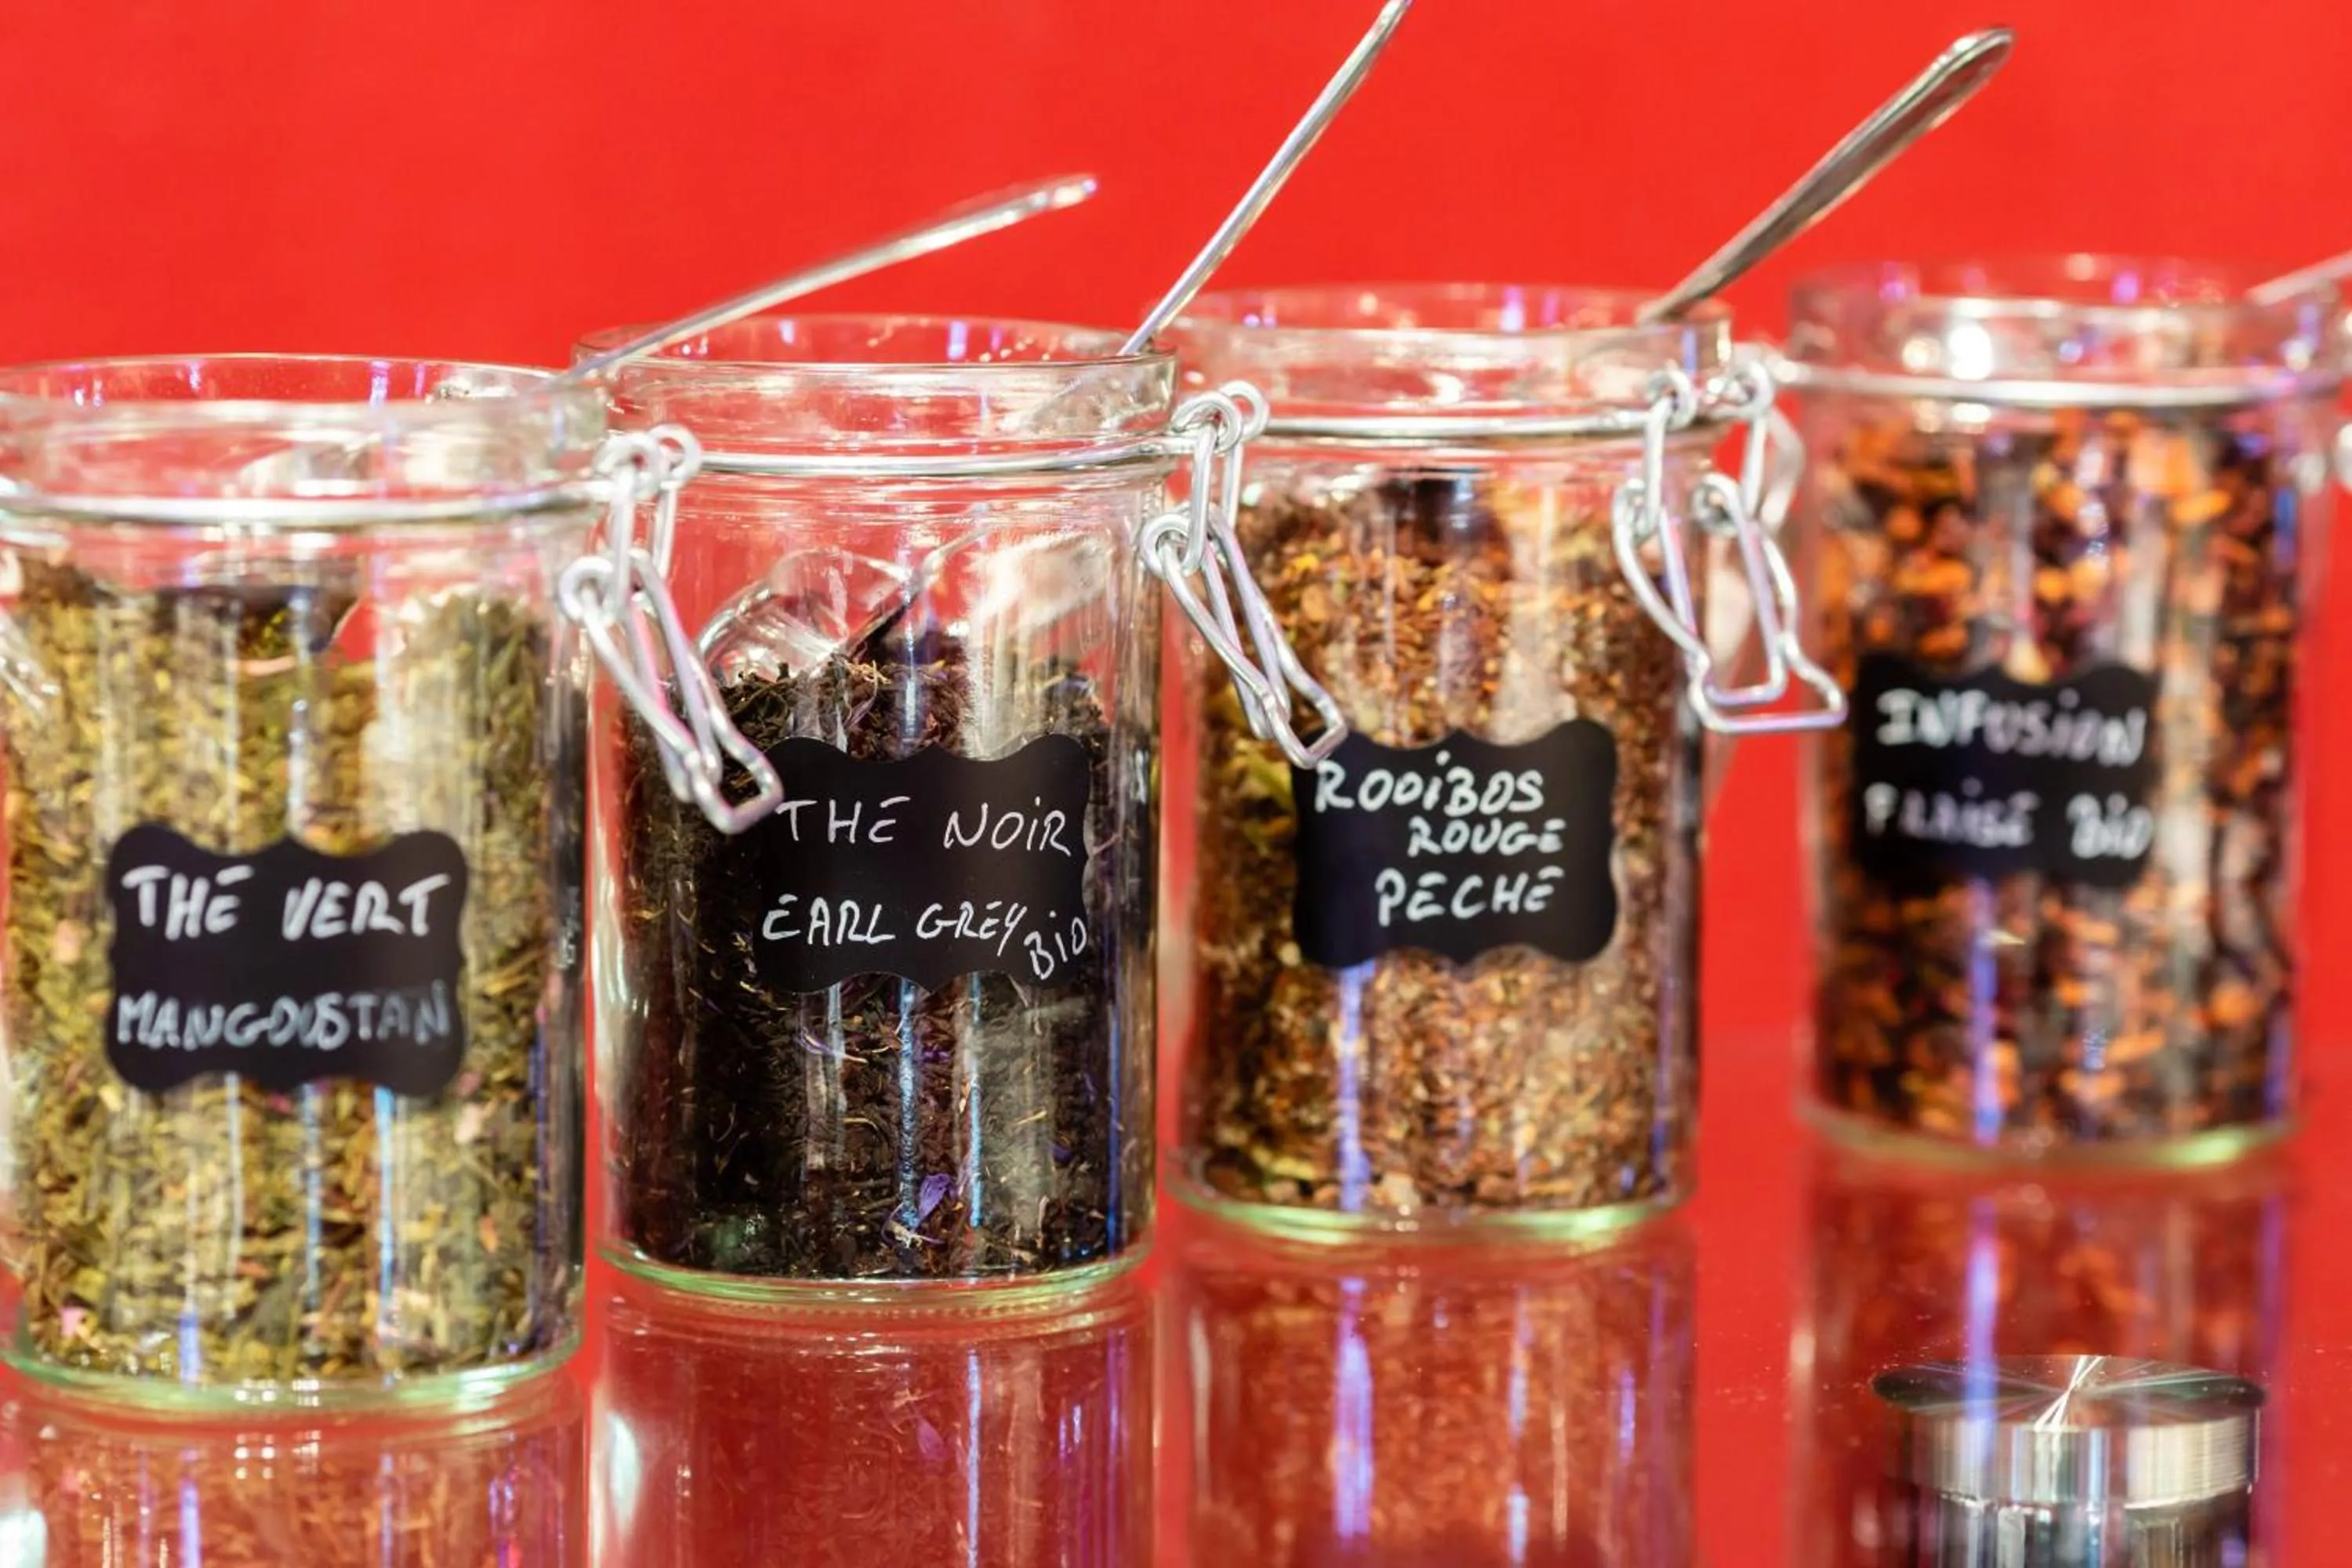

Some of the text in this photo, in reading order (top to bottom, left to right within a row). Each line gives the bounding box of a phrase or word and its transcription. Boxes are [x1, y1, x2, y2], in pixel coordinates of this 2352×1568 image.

[1408, 816, 1566, 857] ROUGE
[281, 873, 450, 941] VERT
[762, 894, 1028, 957] EARL GREY
[118, 978, 450, 1051] MANGOUSTAN
